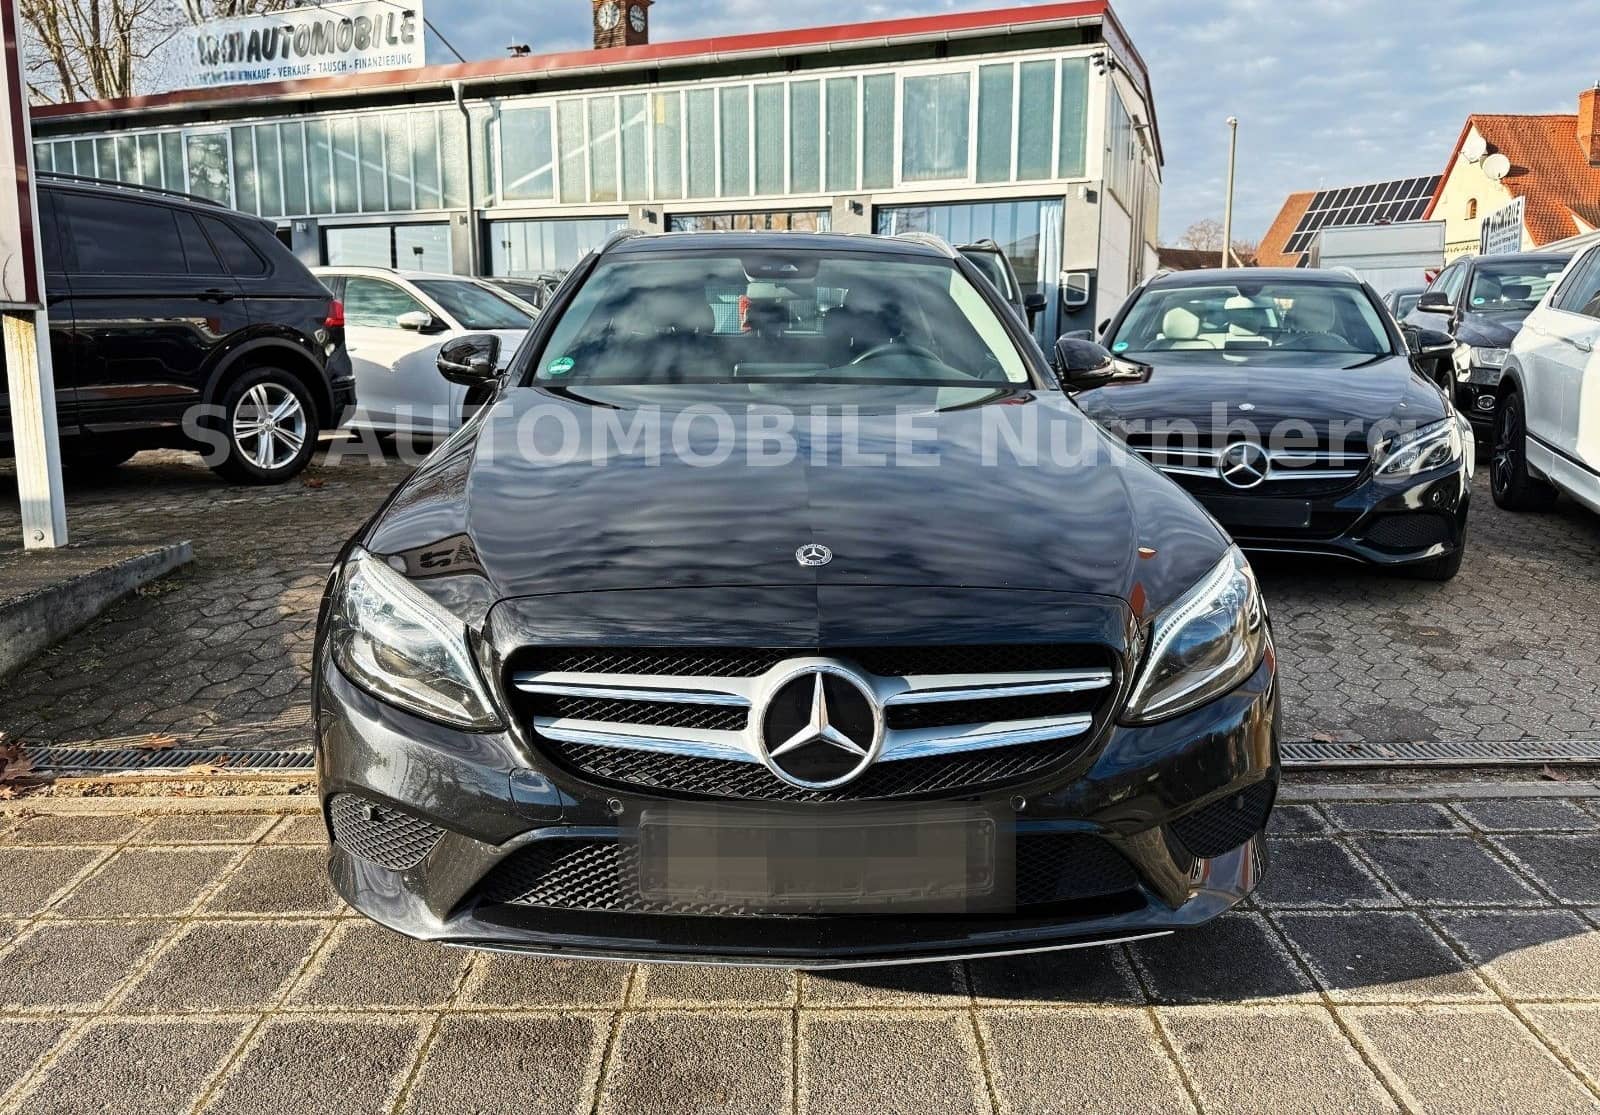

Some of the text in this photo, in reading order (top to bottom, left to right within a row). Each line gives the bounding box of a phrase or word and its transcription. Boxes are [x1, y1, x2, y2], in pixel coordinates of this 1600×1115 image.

[247, 10, 416, 63] AUTOMOBILE
[278, 64, 311, 78] VERKAUF
[319, 60, 347, 74] TAUSCH
[354, 53, 412, 71] FINANZIERUNG
